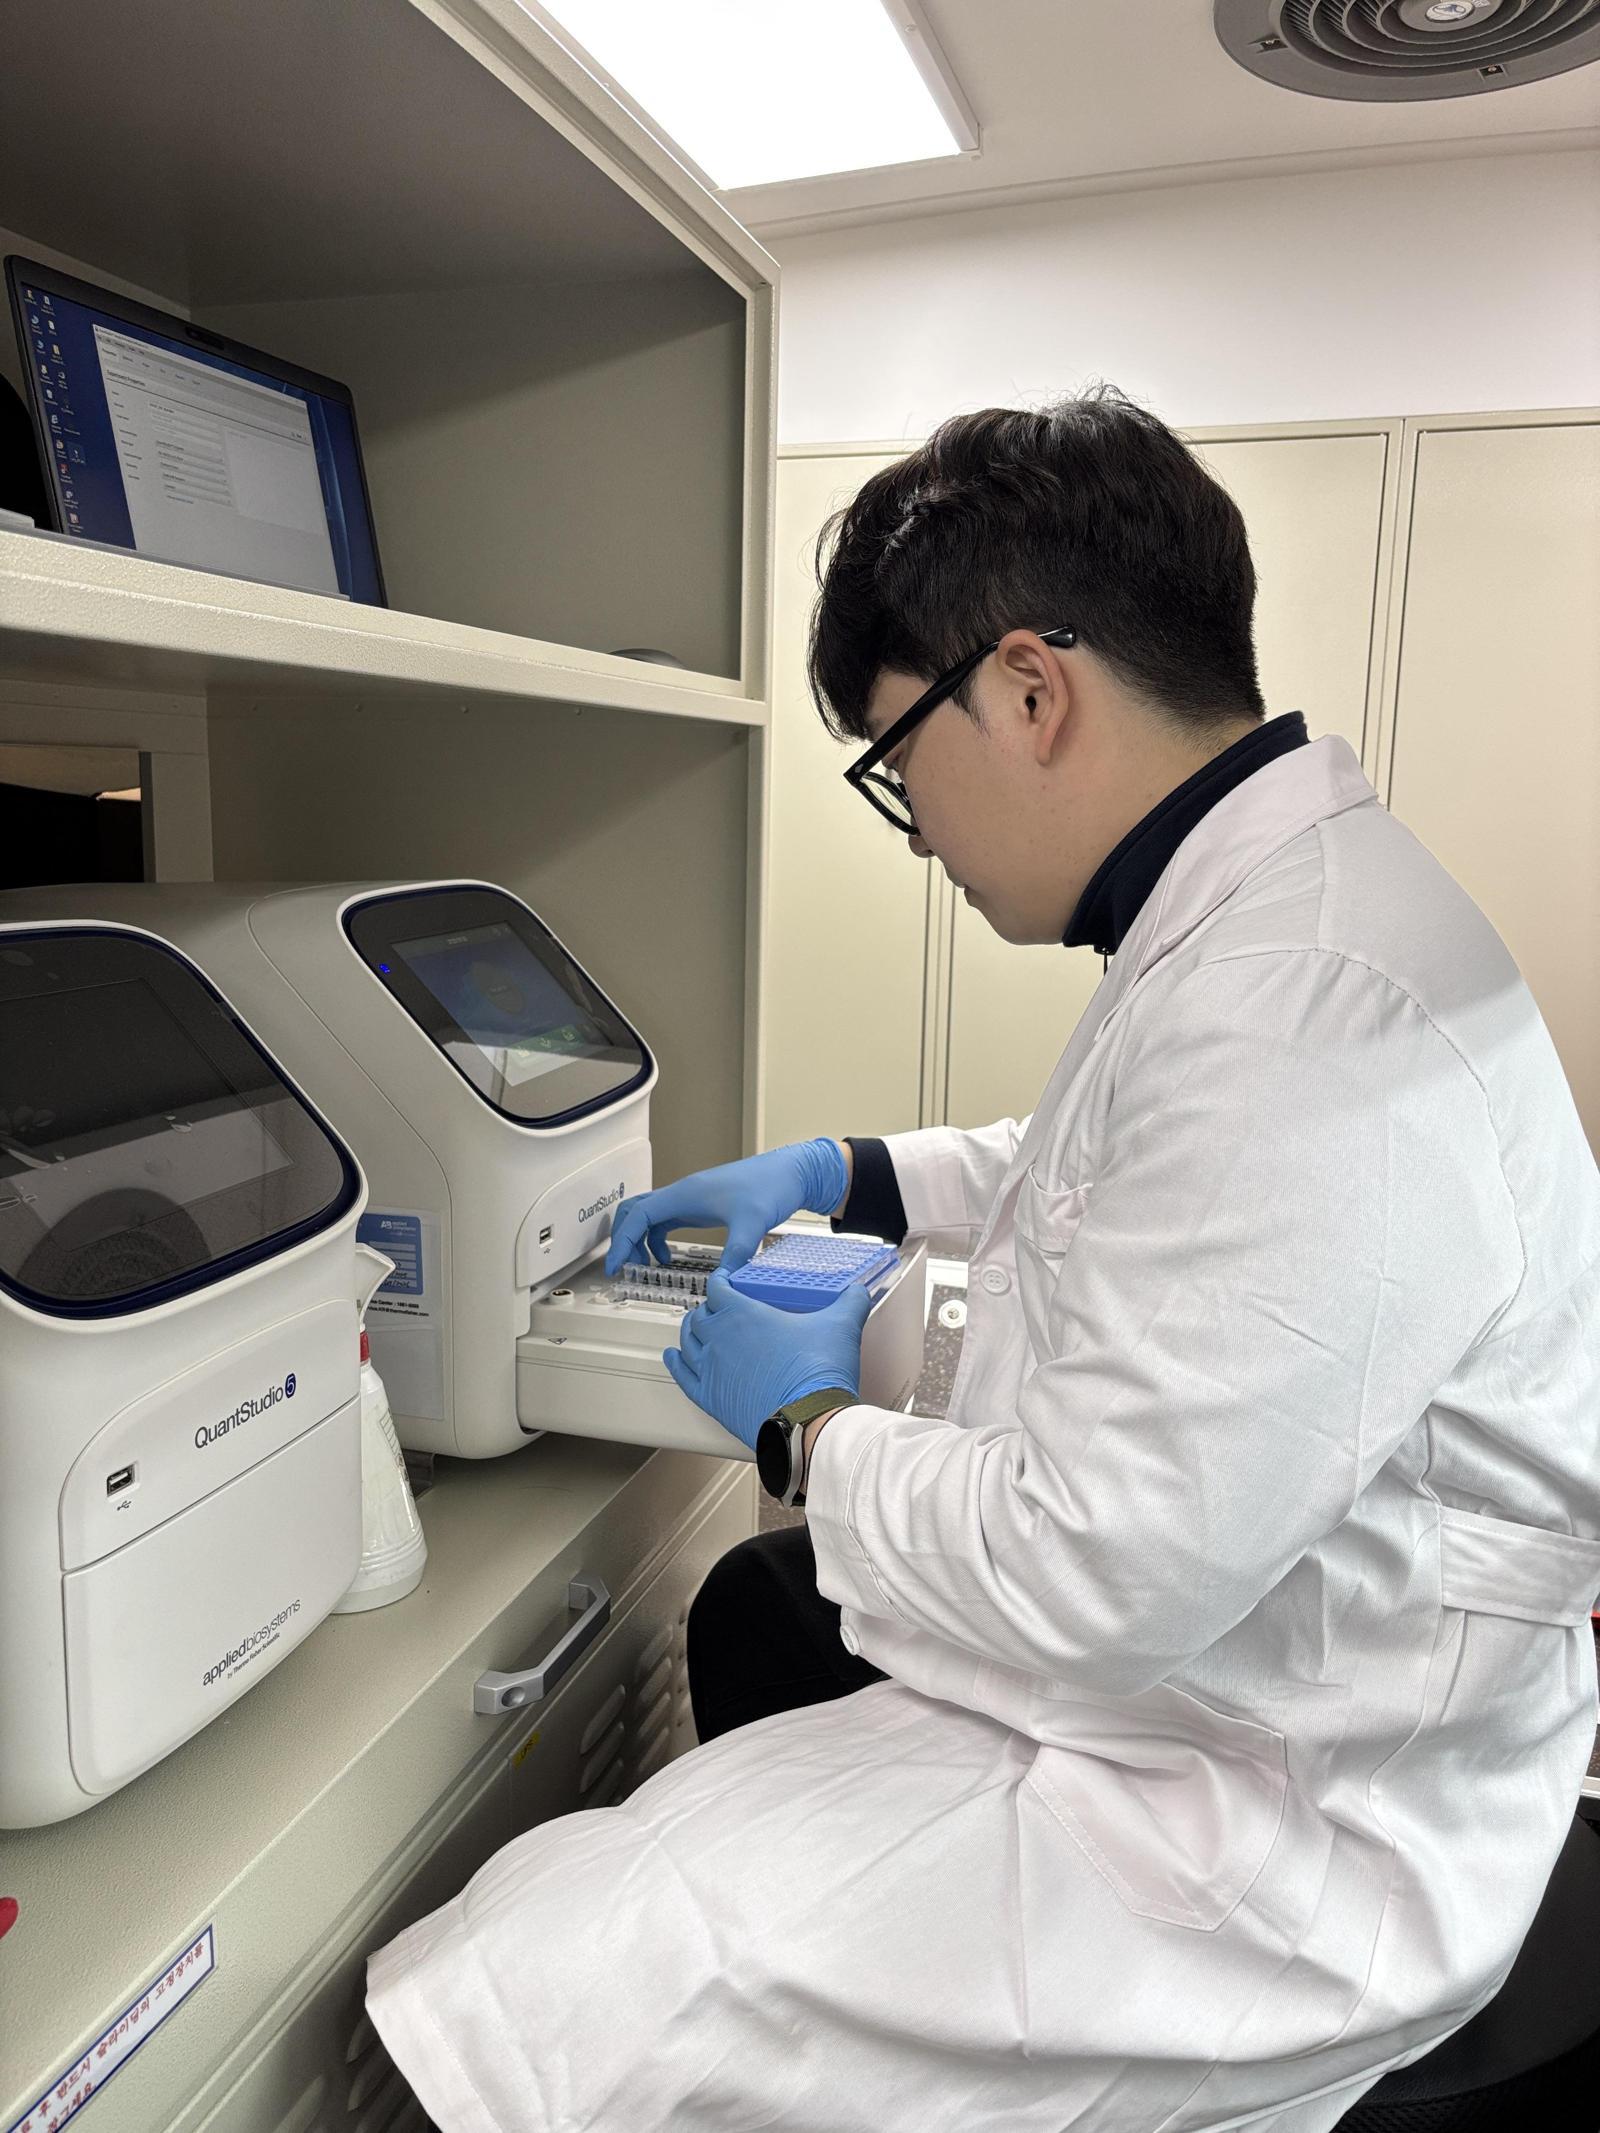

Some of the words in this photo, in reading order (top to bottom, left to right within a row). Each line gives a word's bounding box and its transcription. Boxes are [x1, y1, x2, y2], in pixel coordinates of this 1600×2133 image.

[578, 1189, 619, 1223] QuantStudio
[194, 1385, 284, 1449] QuantStudio
[285, 1373, 296, 1399] 5
[203, 1599, 301, 1686] appliedbiosystems
[233, 1658, 250, 1674] Thermo
[249, 1648, 262, 1661] Fisher
[262, 1632, 281, 1651] Scientific
[56, 2056, 91, 2100] 반드시
[97, 1996, 151, 2058] 슬라이딩의
[154, 1942, 205, 2001] 고정장치를
